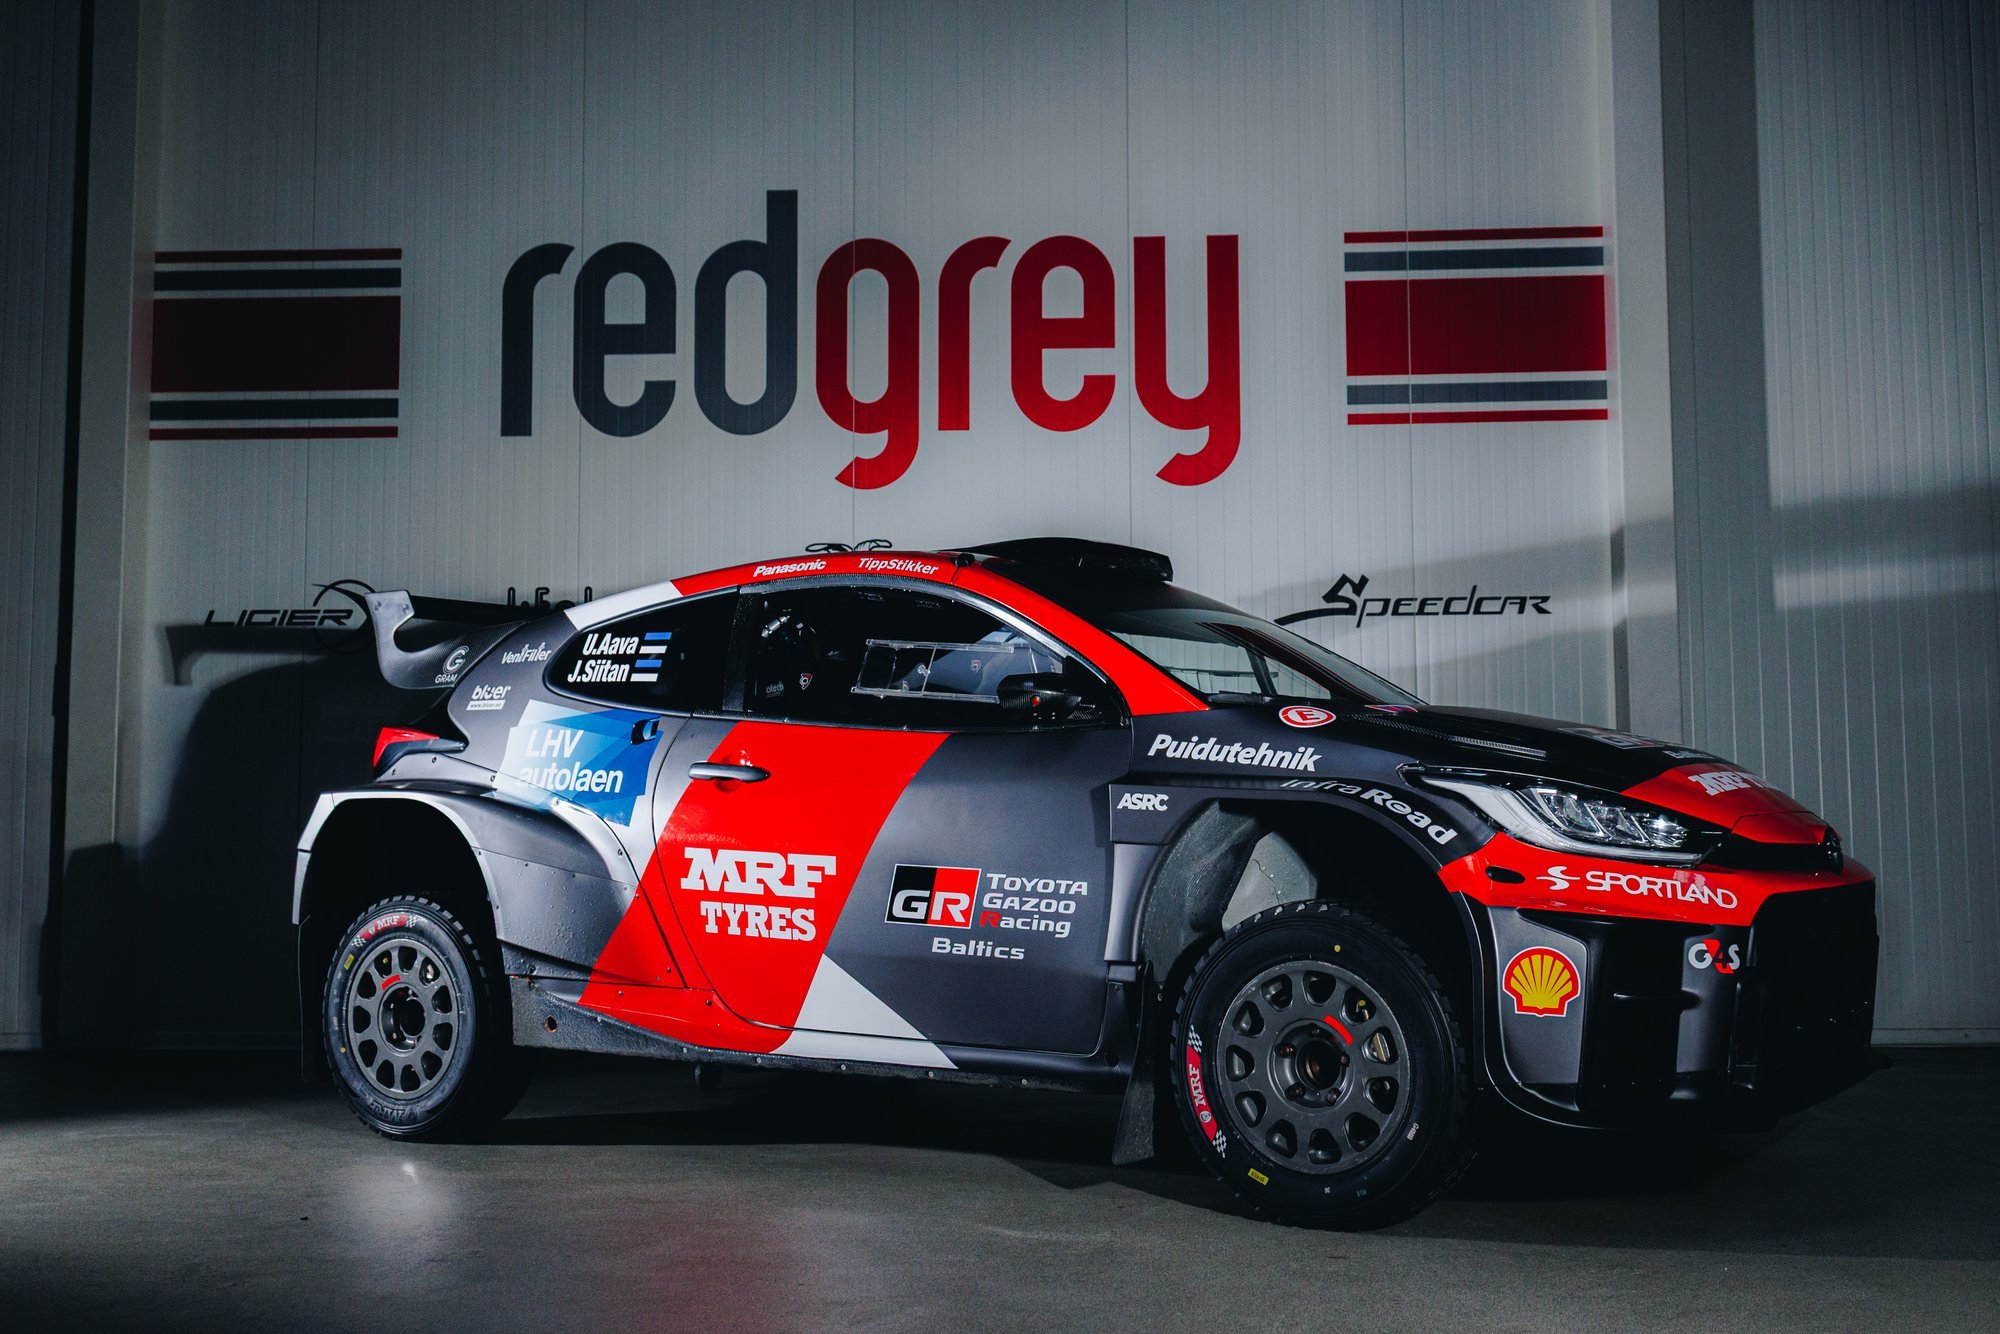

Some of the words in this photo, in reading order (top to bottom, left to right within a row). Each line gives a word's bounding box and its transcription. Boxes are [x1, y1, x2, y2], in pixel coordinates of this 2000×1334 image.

[500, 189, 1241, 489] redgrey
[753, 559, 827, 577] Panasonic
[858, 558, 939, 575] TippStikker
[204, 609, 353, 627] LIGIER
[501, 642, 551, 665] VentFilter
[582, 633, 640, 655] U.Aava
[567, 659, 630, 682] J.Siitan
[526, 729, 584, 758] LHV
[1148, 734, 1322, 772] Puidutehnik
[517, 762, 623, 793] autolaen
[1117, 793, 1169, 811] ASRC
[680, 846, 837, 898] MRF
[986, 873, 1088, 896] TOYOTA
[1586, 871, 1738, 909] SPORTLAND
[892, 889, 970, 921] GR
[982, 893, 1077, 915] GAZOO
[700, 901, 816, 942] TYRES
[979, 911, 1071, 938] Racing
[931, 937, 1025, 960] Baltics
[1688, 940, 1740, 973] G4S
[1188, 1064, 1206, 1107] MRF
